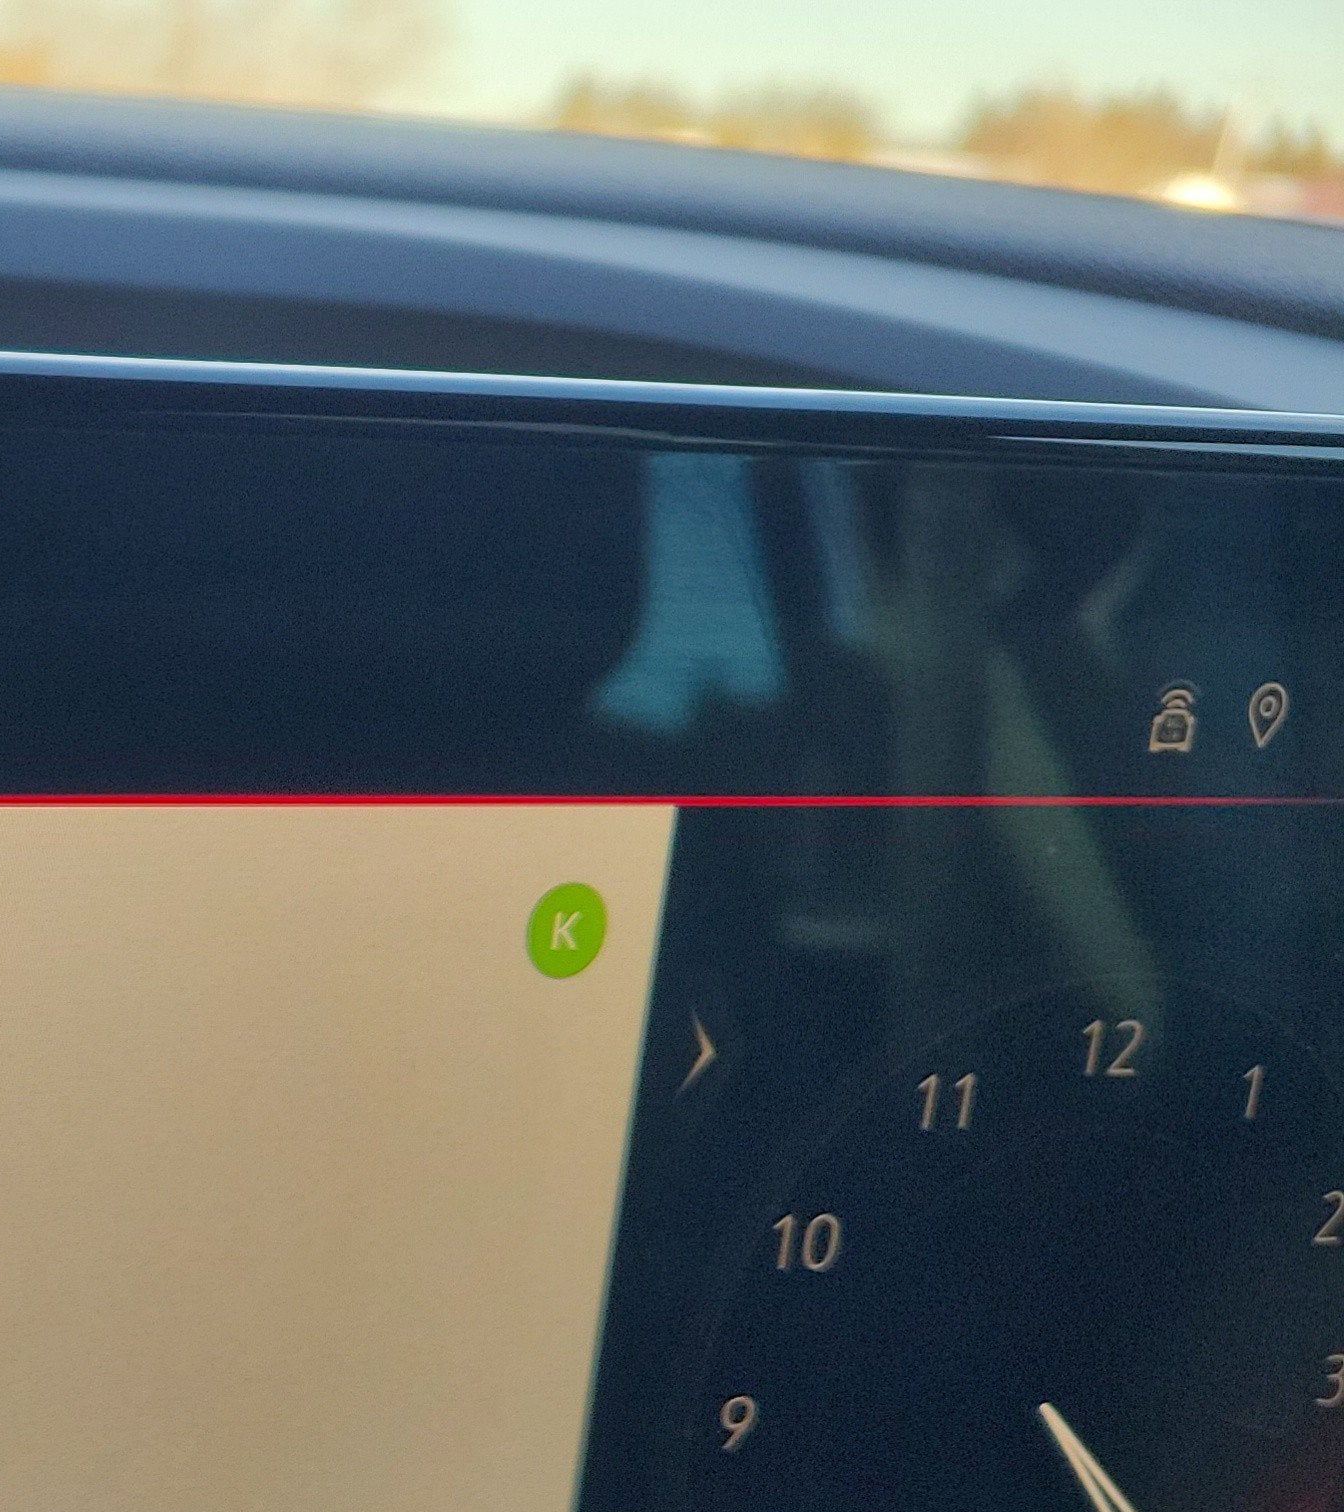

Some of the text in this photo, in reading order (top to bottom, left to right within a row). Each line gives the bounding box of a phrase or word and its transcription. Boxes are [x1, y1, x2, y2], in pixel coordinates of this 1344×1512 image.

[549, 910, 584, 952] K
[1082, 1018, 1144, 1078] 12
[917, 1072, 978, 1130] 11
[1243, 1064, 1265, 1120] 1
[772, 1212, 844, 1272] 10
[1314, 1189, 1344, 1245] 2
[720, 1394, 757, 1451] 9
